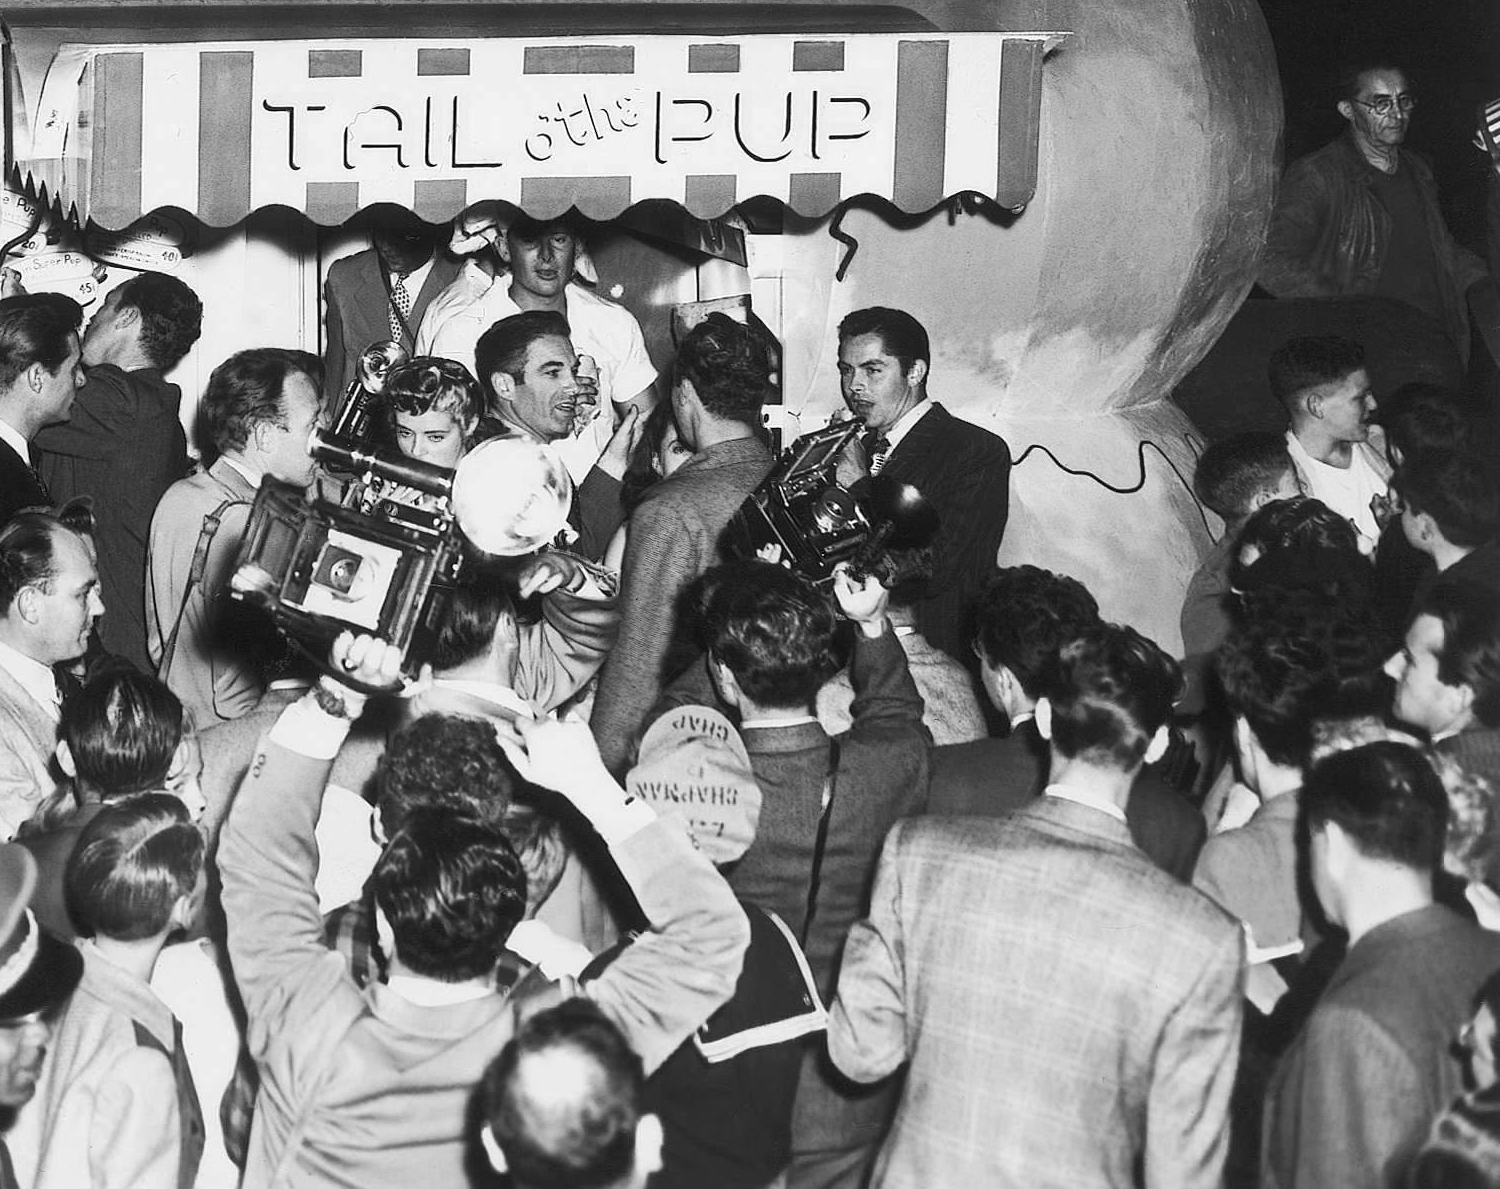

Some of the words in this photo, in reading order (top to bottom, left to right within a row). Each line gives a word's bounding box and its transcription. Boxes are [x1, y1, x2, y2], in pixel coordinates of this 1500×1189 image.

[263, 95, 503, 170] TAIL
[655, 90, 871, 164] PUP
[16, 197, 36, 218] Pup
[149, 216, 169, 238] Pup
[635, 781, 739, 806] CHAPMAN
